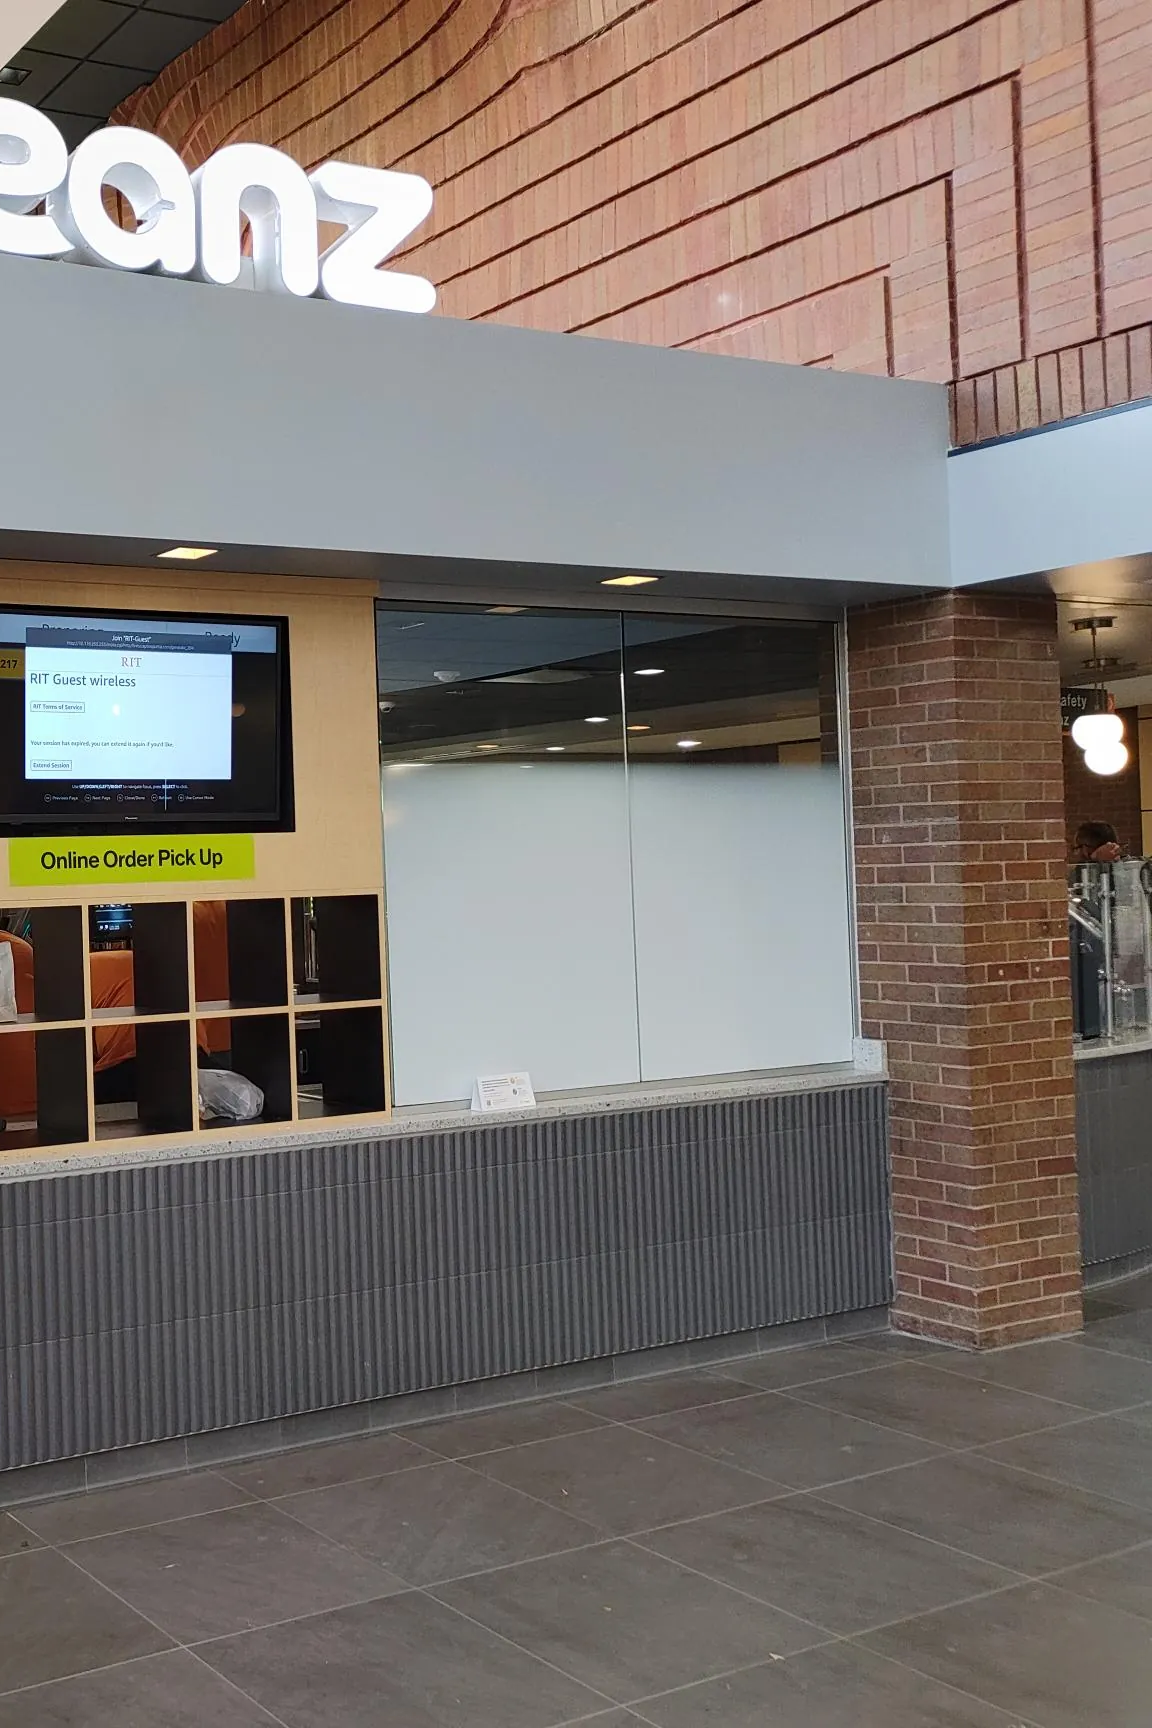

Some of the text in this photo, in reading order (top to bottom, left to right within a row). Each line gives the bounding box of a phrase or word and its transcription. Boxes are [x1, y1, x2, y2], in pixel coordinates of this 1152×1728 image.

[0, 660, 18, 668] 217
[121, 656, 142, 668] RIT
[30, 673, 136, 687] RIT Guest wireless
[1060, 693, 1087, 710] afety
[40, 848, 223, 870] Online Order Pick Up
